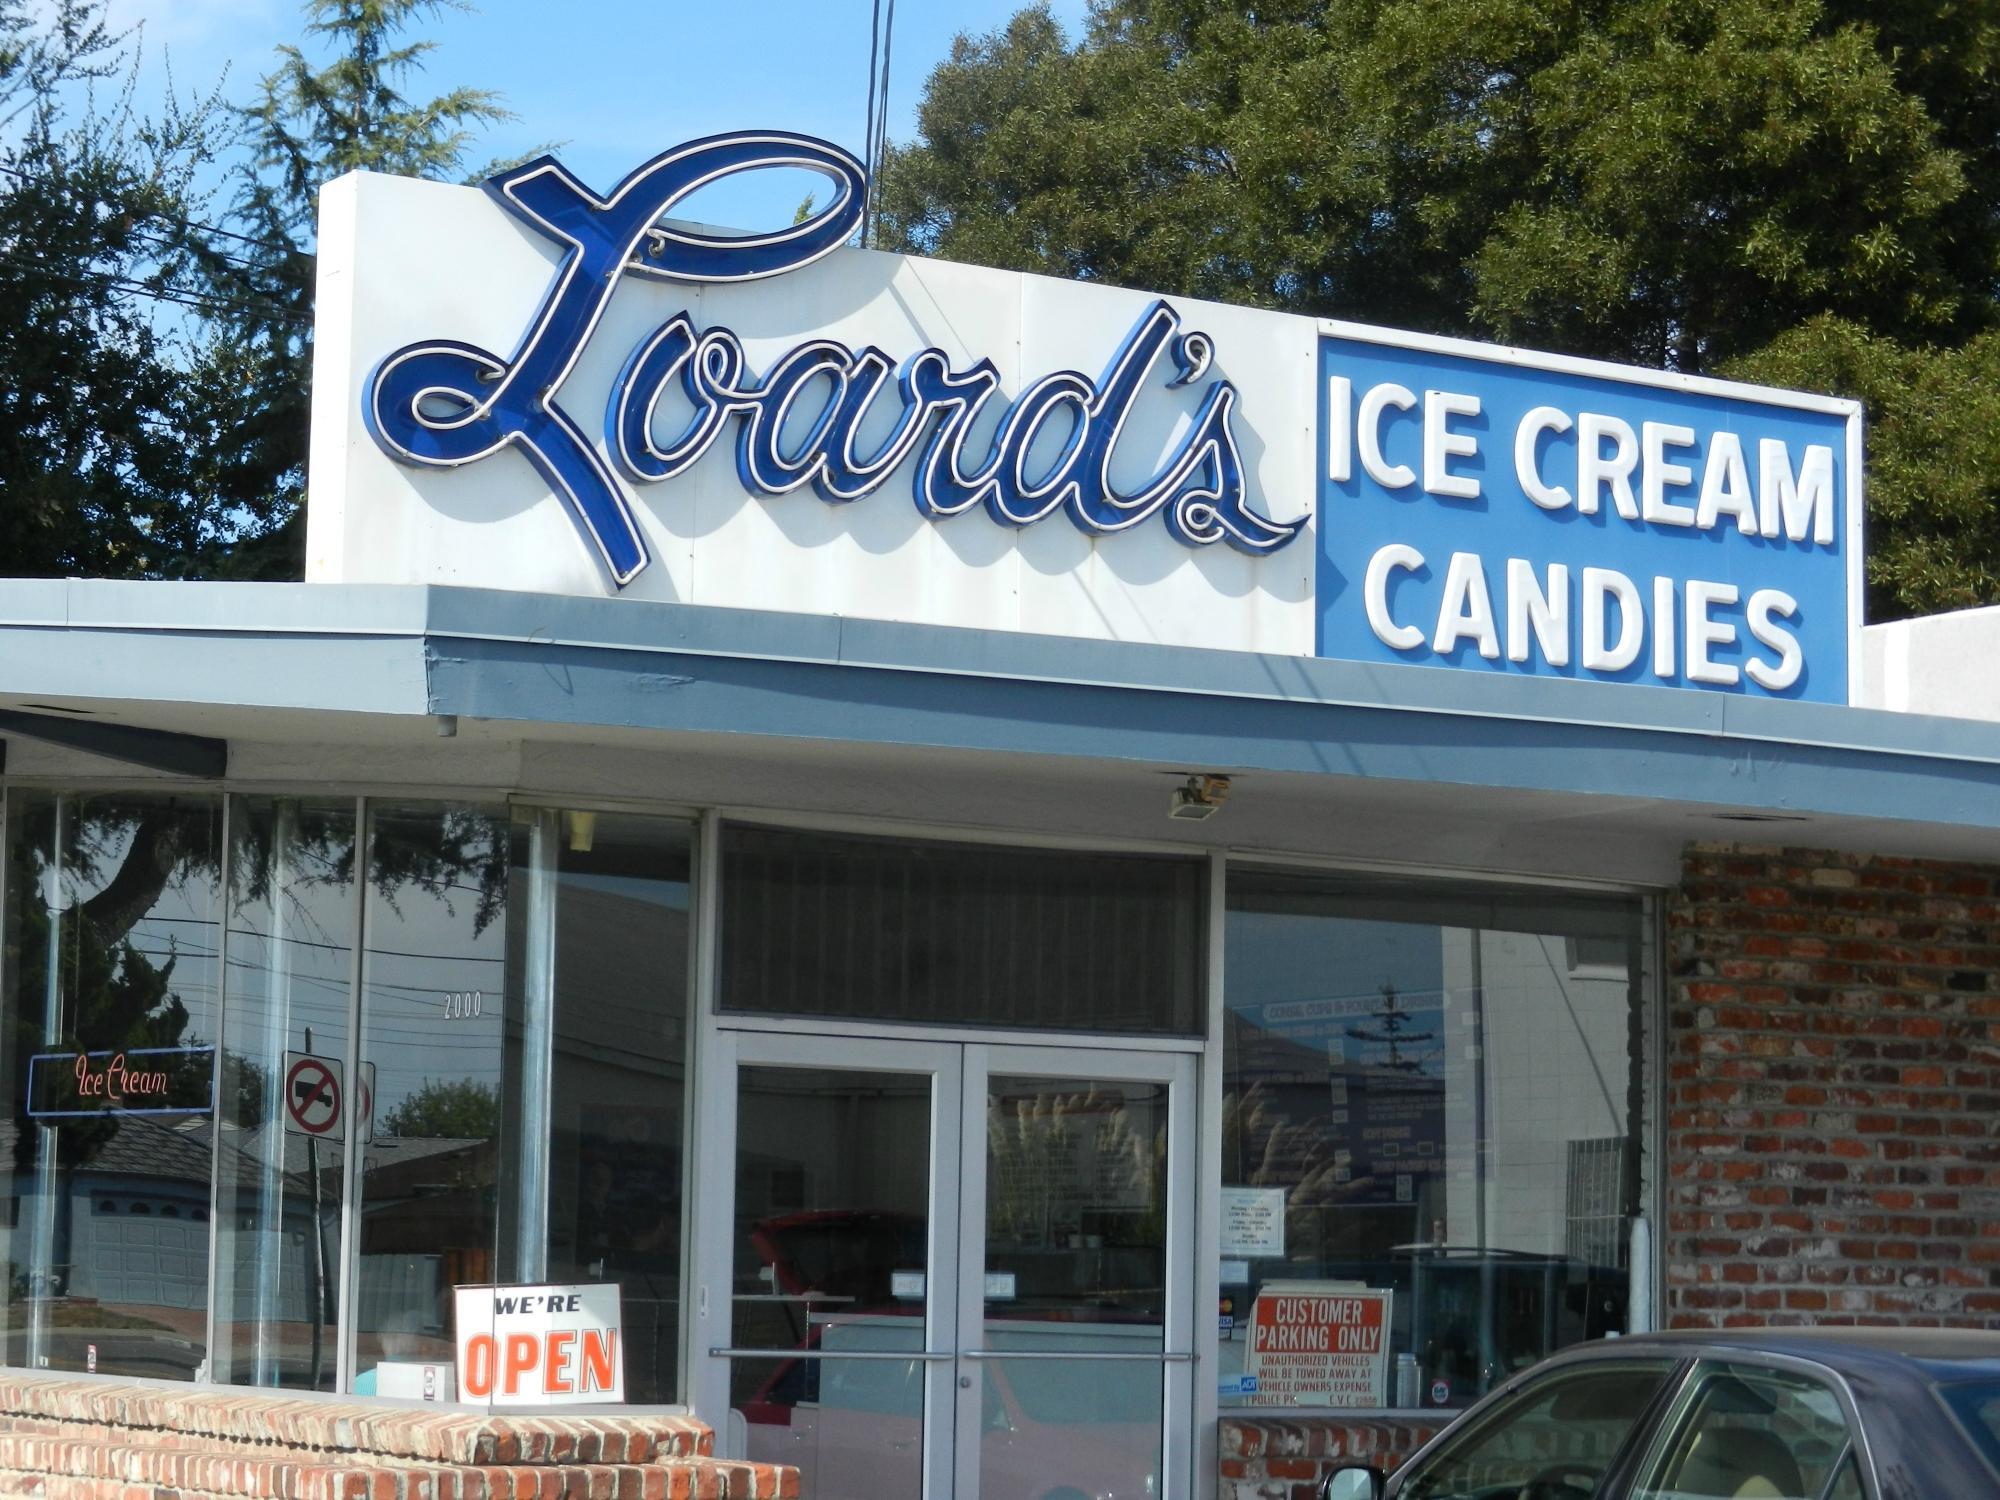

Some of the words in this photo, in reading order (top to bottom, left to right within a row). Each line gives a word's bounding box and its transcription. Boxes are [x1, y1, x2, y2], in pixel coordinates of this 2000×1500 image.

[362, 129, 1312, 590] Loard's
[1329, 376, 1481, 498] ICE
[1514, 406, 1833, 545] CREAM
[1364, 543, 1803, 690] CANDIES
[445, 991, 481, 1019] 2000
[75, 1055, 103, 1095] Ice
[107, 1053, 167, 1100] Cream
[495, 1294, 581, 1314] WE'RE
[1276, 1298, 1363, 1324] CUSTOMER
[1256, 1325, 1329, 1350] PARKING
[1338, 1326, 1380, 1351] ONLY
[463, 1328, 617, 1398] OPEN
[1259, 1368, 1279, 1379] WILL
[1281, 1368, 1292, 1379] BE
[1296, 1368, 1326, 1379] TOWED
[1328, 1368, 1357, 1379] AWAY
[1360, 1368, 1372, 1379] AT
[1262, 1355, 1328, 1366] UNAUTHORIZED
[1331, 1356, 1370, 1366] VEHICLES
[1259, 1381, 1291, 1392] VEHICLE
[1294, 1381, 1331, 1392] OWNERS
[1334, 1381, 1371, 1392] EXPENSE
[1251, 1394, 1281, 1406] POLICE
